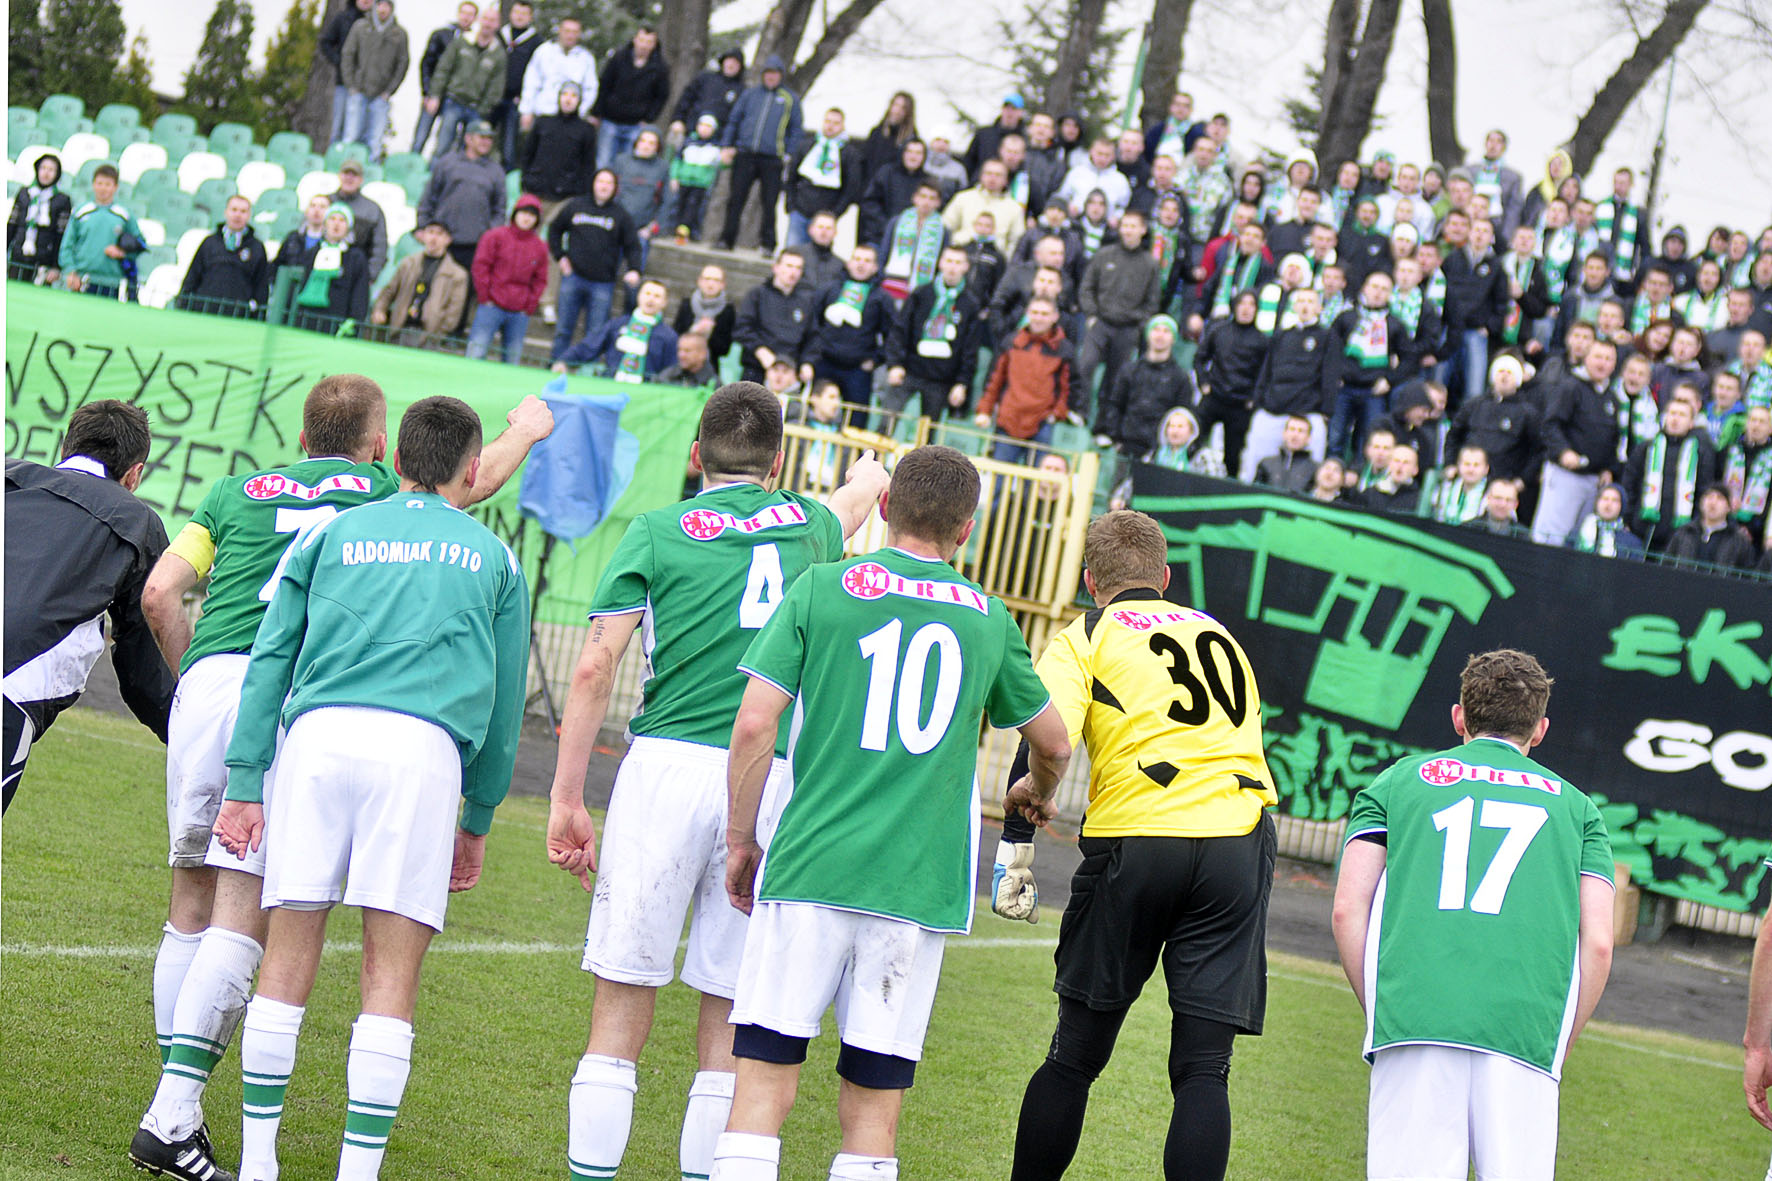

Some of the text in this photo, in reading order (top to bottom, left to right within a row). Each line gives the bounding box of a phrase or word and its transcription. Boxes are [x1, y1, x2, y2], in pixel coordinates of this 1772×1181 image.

[342, 540, 482, 573] RADOMIAK 1910
[739, 542, 785, 629] 4
[857, 617, 964, 756] 10
[1149, 630, 1247, 728] 30
[1601, 608, 1772, 690] EK
[1432, 795, 1550, 915] 17
